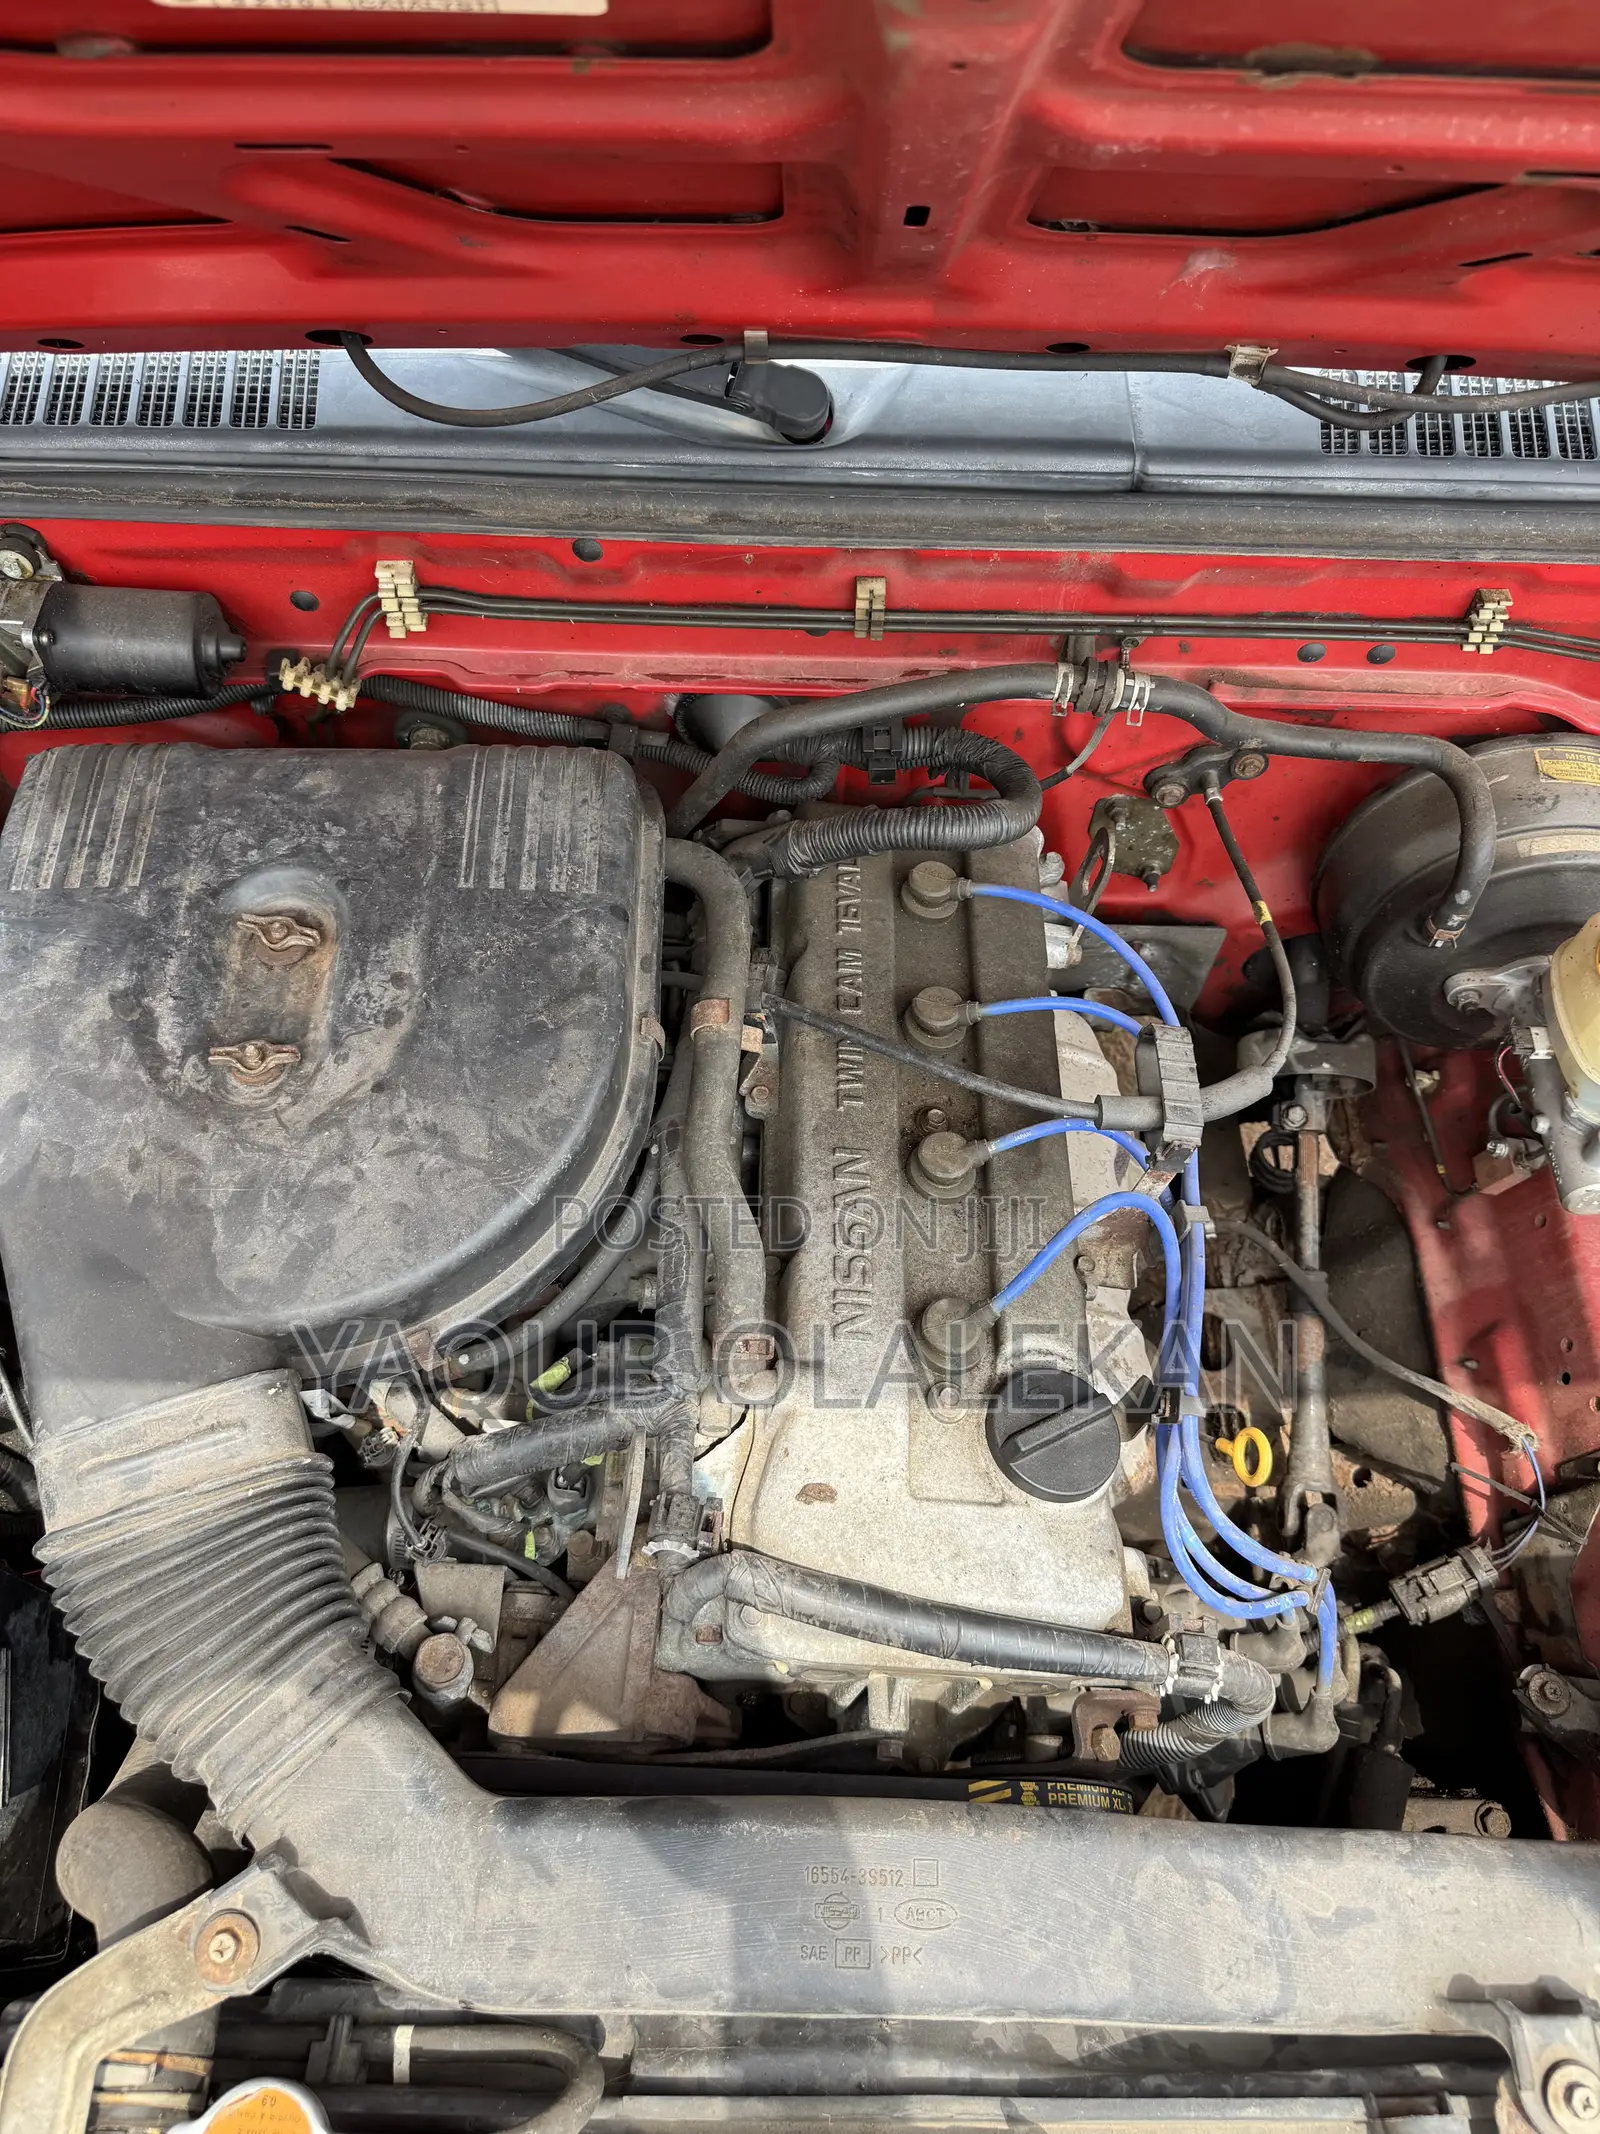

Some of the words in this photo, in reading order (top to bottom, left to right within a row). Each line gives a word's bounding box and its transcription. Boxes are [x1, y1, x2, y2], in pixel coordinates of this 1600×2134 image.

[836, 949, 863, 1015] CAM
[833, 1147, 873, 1342] NISSAN
[1048, 1792, 1110, 1809] PREMIUM
[804, 1865, 904, 1887] 16554-3S512
[800, 1944, 828, 1961] SAE
[844, 1946, 861, 1962] PP
